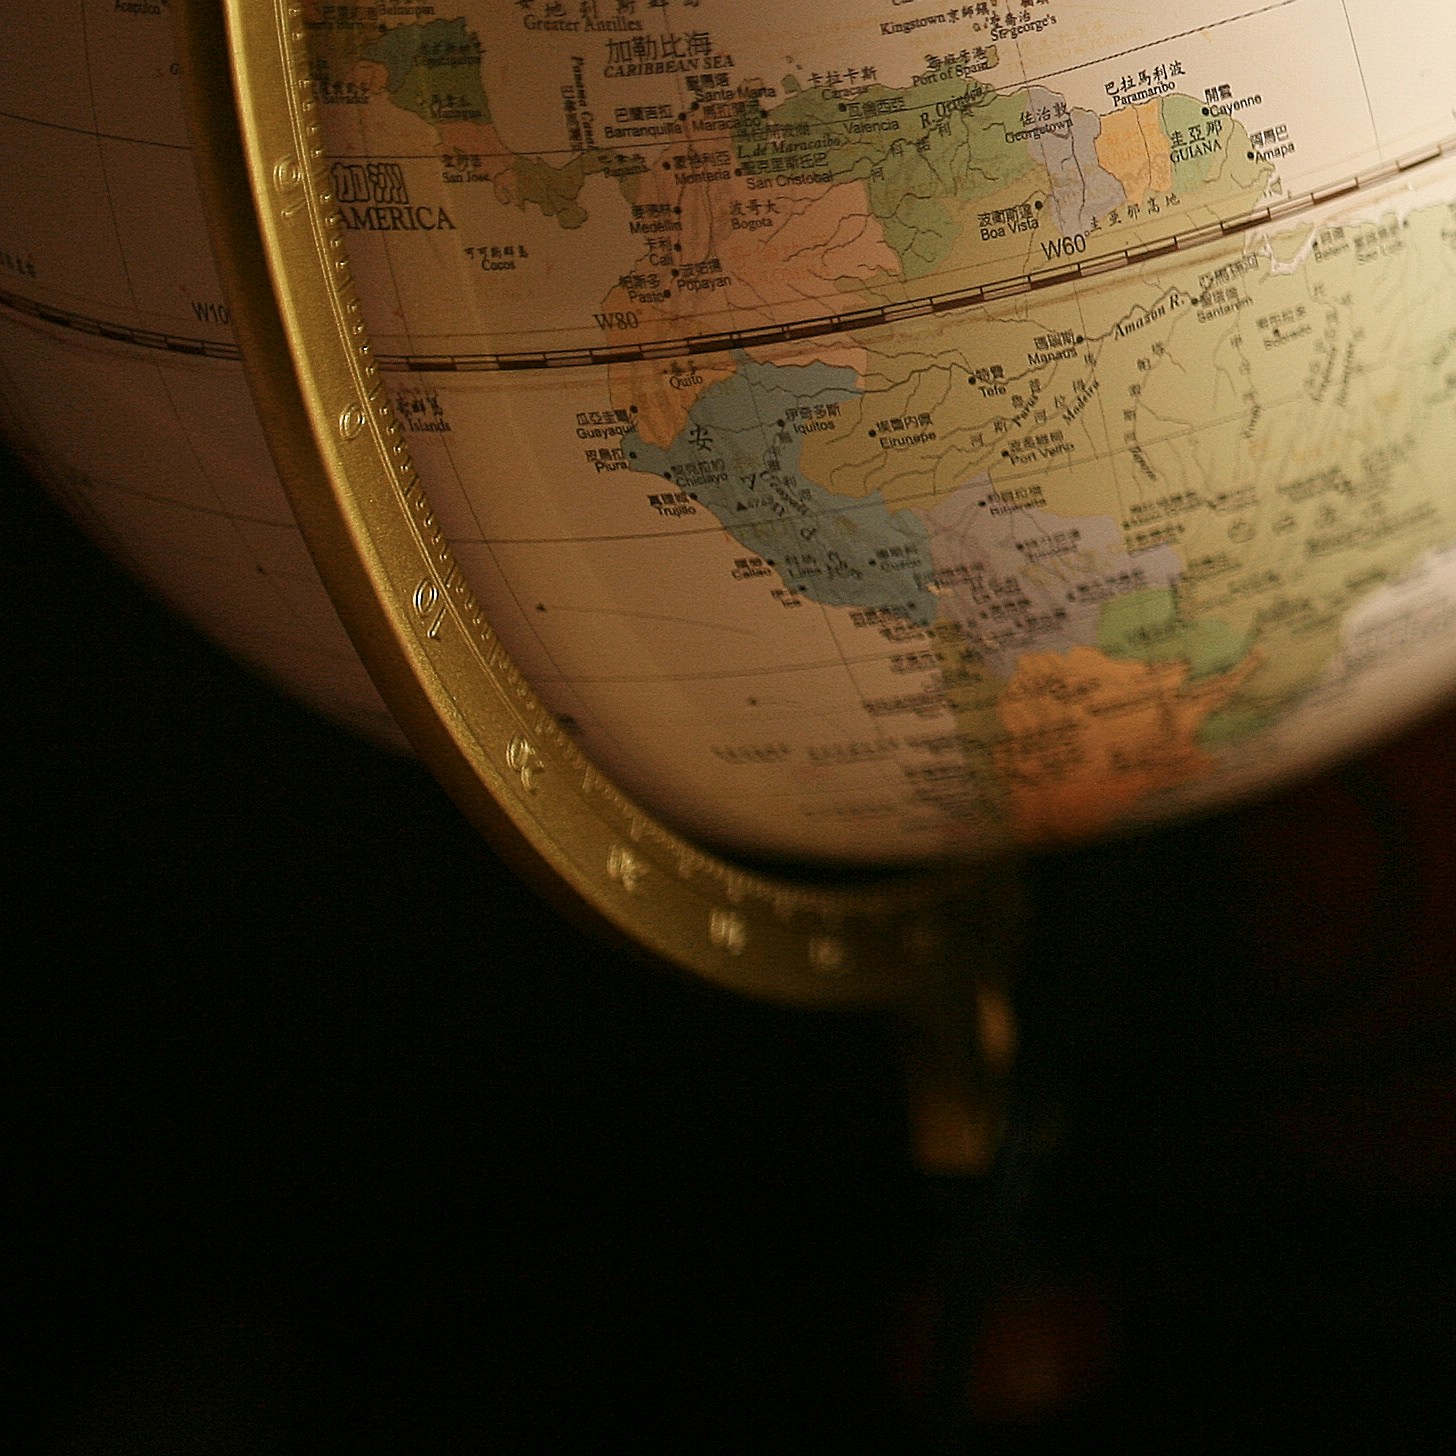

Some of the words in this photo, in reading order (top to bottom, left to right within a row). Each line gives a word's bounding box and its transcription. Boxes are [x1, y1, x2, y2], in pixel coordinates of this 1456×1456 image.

[523, 14, 580, 32] Greater
[880, 11, 947, 37] Kingstown
[606, 30, 713, 65] 加勒比海
[603, 57, 703, 79] CARIBBEAN
[703, 53, 736, 71] SEA
[911, 72, 938, 88] Port
[939, 69, 955, 82] of
[695, 86, 734, 103] Santa
[1112, 79, 1177, 108] Paramaribo
[603, 121, 683, 141] Barranquilla
[843, 115, 902, 136] Valencia
[1003, 117, 1075, 146] Georgetown
[1169, 138, 1223, 166] GUIANA
[1252, 141, 1297, 165] Amapa
[745, 172, 775, 192] San
[334, 203, 458, 232] AMERICA
[730, 213, 775, 232] Bogota
[979, 224, 1009, 243] Boa
[1008, 215, 1040, 237] Vista
[676, 273, 732, 293] Popayan
[1168, 293, 1187, 311] R.
[668, 372, 705, 392] Quito
[791, 417, 837, 435] Iquitos
